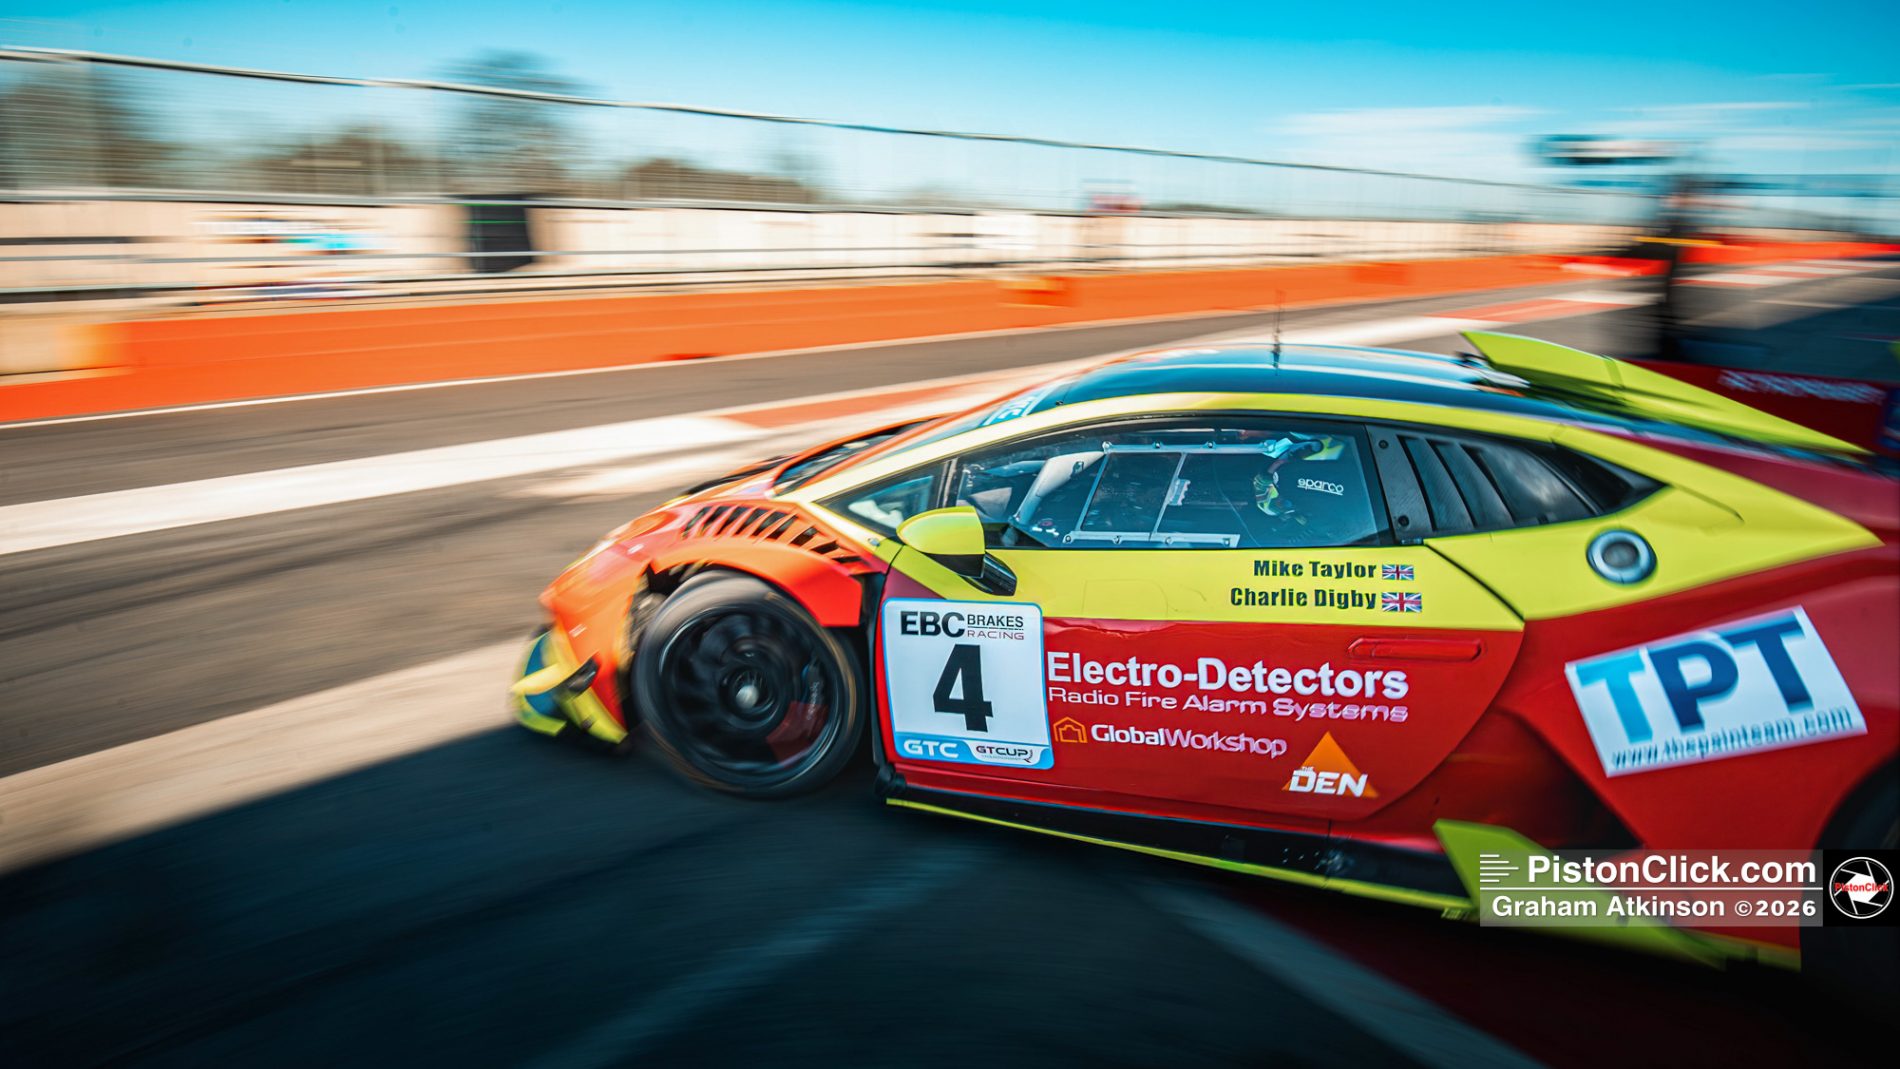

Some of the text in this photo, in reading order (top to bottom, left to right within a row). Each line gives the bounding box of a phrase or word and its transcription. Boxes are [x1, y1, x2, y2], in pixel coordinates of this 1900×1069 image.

[1254, 560, 1377, 579] Mike Taylor
[1230, 587, 1377, 609] Charlie Digby
[900, 611, 1024, 638] EBC BRAKES
[967, 629, 1025, 641] RACING
[932, 643, 994, 733] 4
[1047, 651, 1409, 700] Electro-Detectors
[1575, 609, 1815, 744] TPT
[1048, 687, 1409, 723] Radio Fire Alarm Systems
[903, 739, 959, 759] GTC
[1288, 769, 1369, 798] DEN
